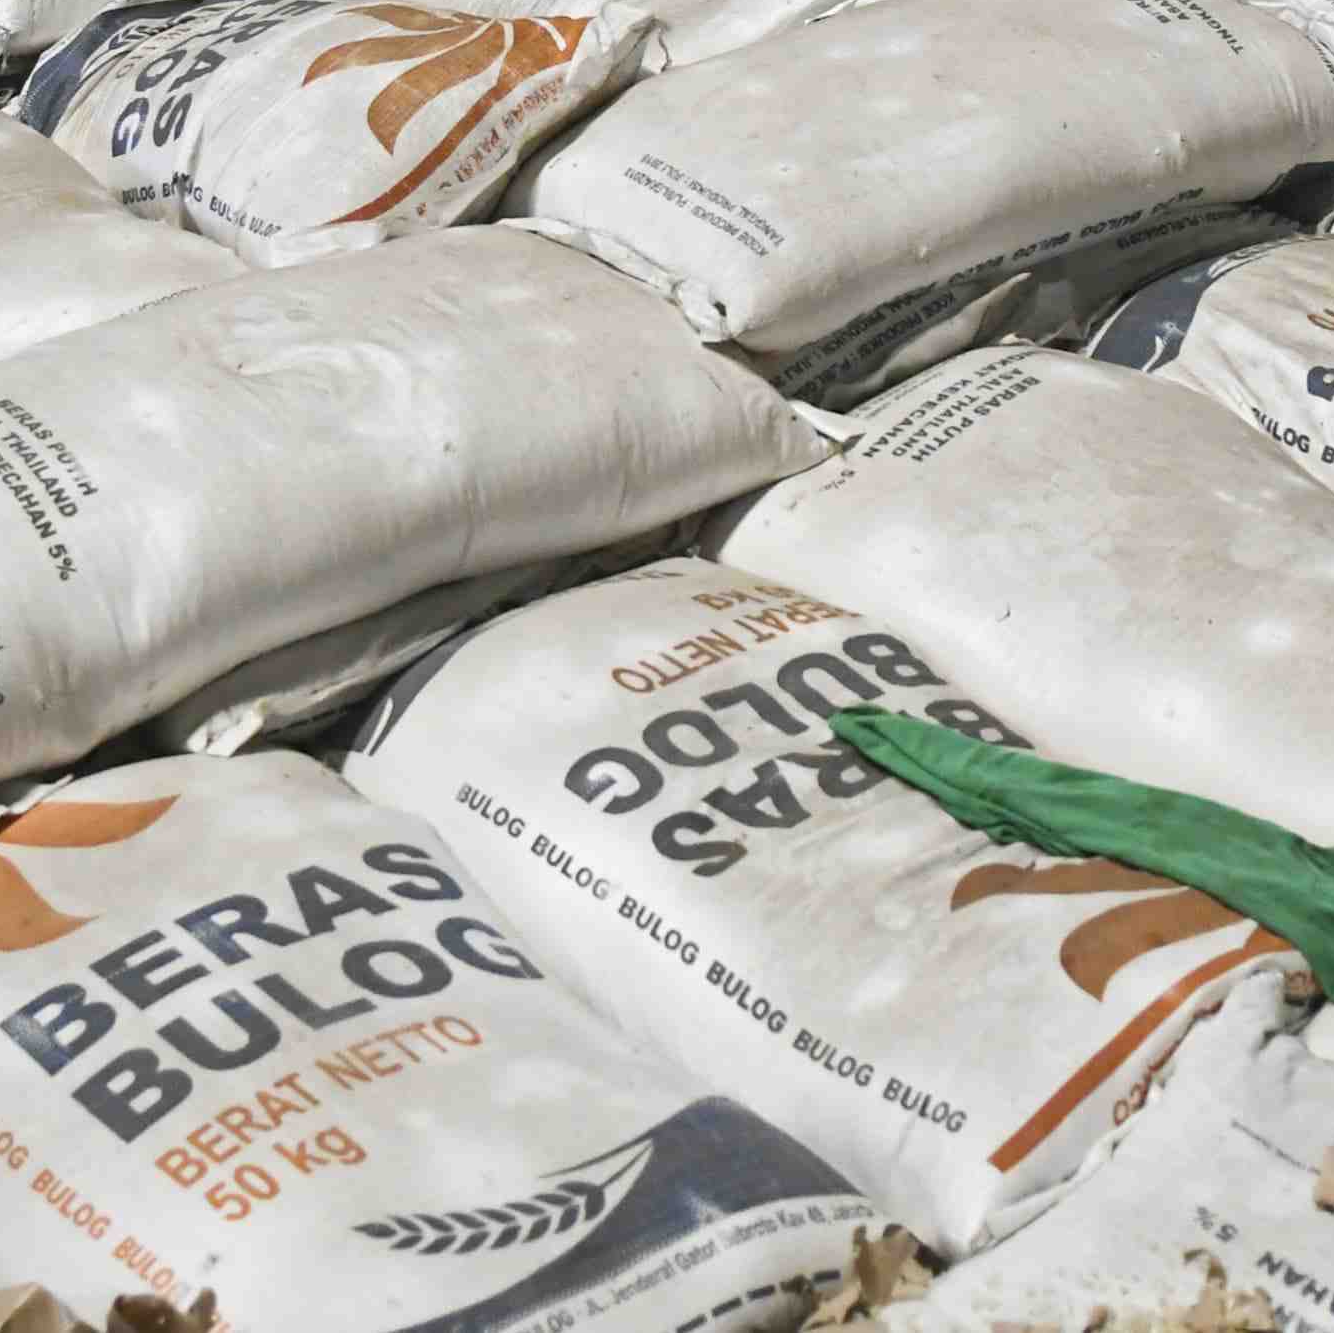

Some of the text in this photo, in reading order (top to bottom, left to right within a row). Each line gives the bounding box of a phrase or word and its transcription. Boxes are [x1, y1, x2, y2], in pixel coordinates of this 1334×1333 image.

[861, 379, 974, 459] KEPECAHAN
[891, 394, 982, 459] THAILAND
[911, 375, 1043, 464] BERAS PUTIH
[2, 432, 80, 519] THAILAND
[46, 542, 80, 583] 5%
[610, 628, 749, 695] NETTO
[563, 632, 948, 817] BULOG
[651, 698, 1035, 878] BRAS
[458, 783, 970, 1135] BULOG BULOG BULOG BULOG BULOG BULOG
[69, 915, 546, 1144] BULOG
[155, 1013, 483, 1191] BERAT NETTO
[30, 1168, 113, 1240] BULOG
[204, 1125, 368, 1223] 50 kg
